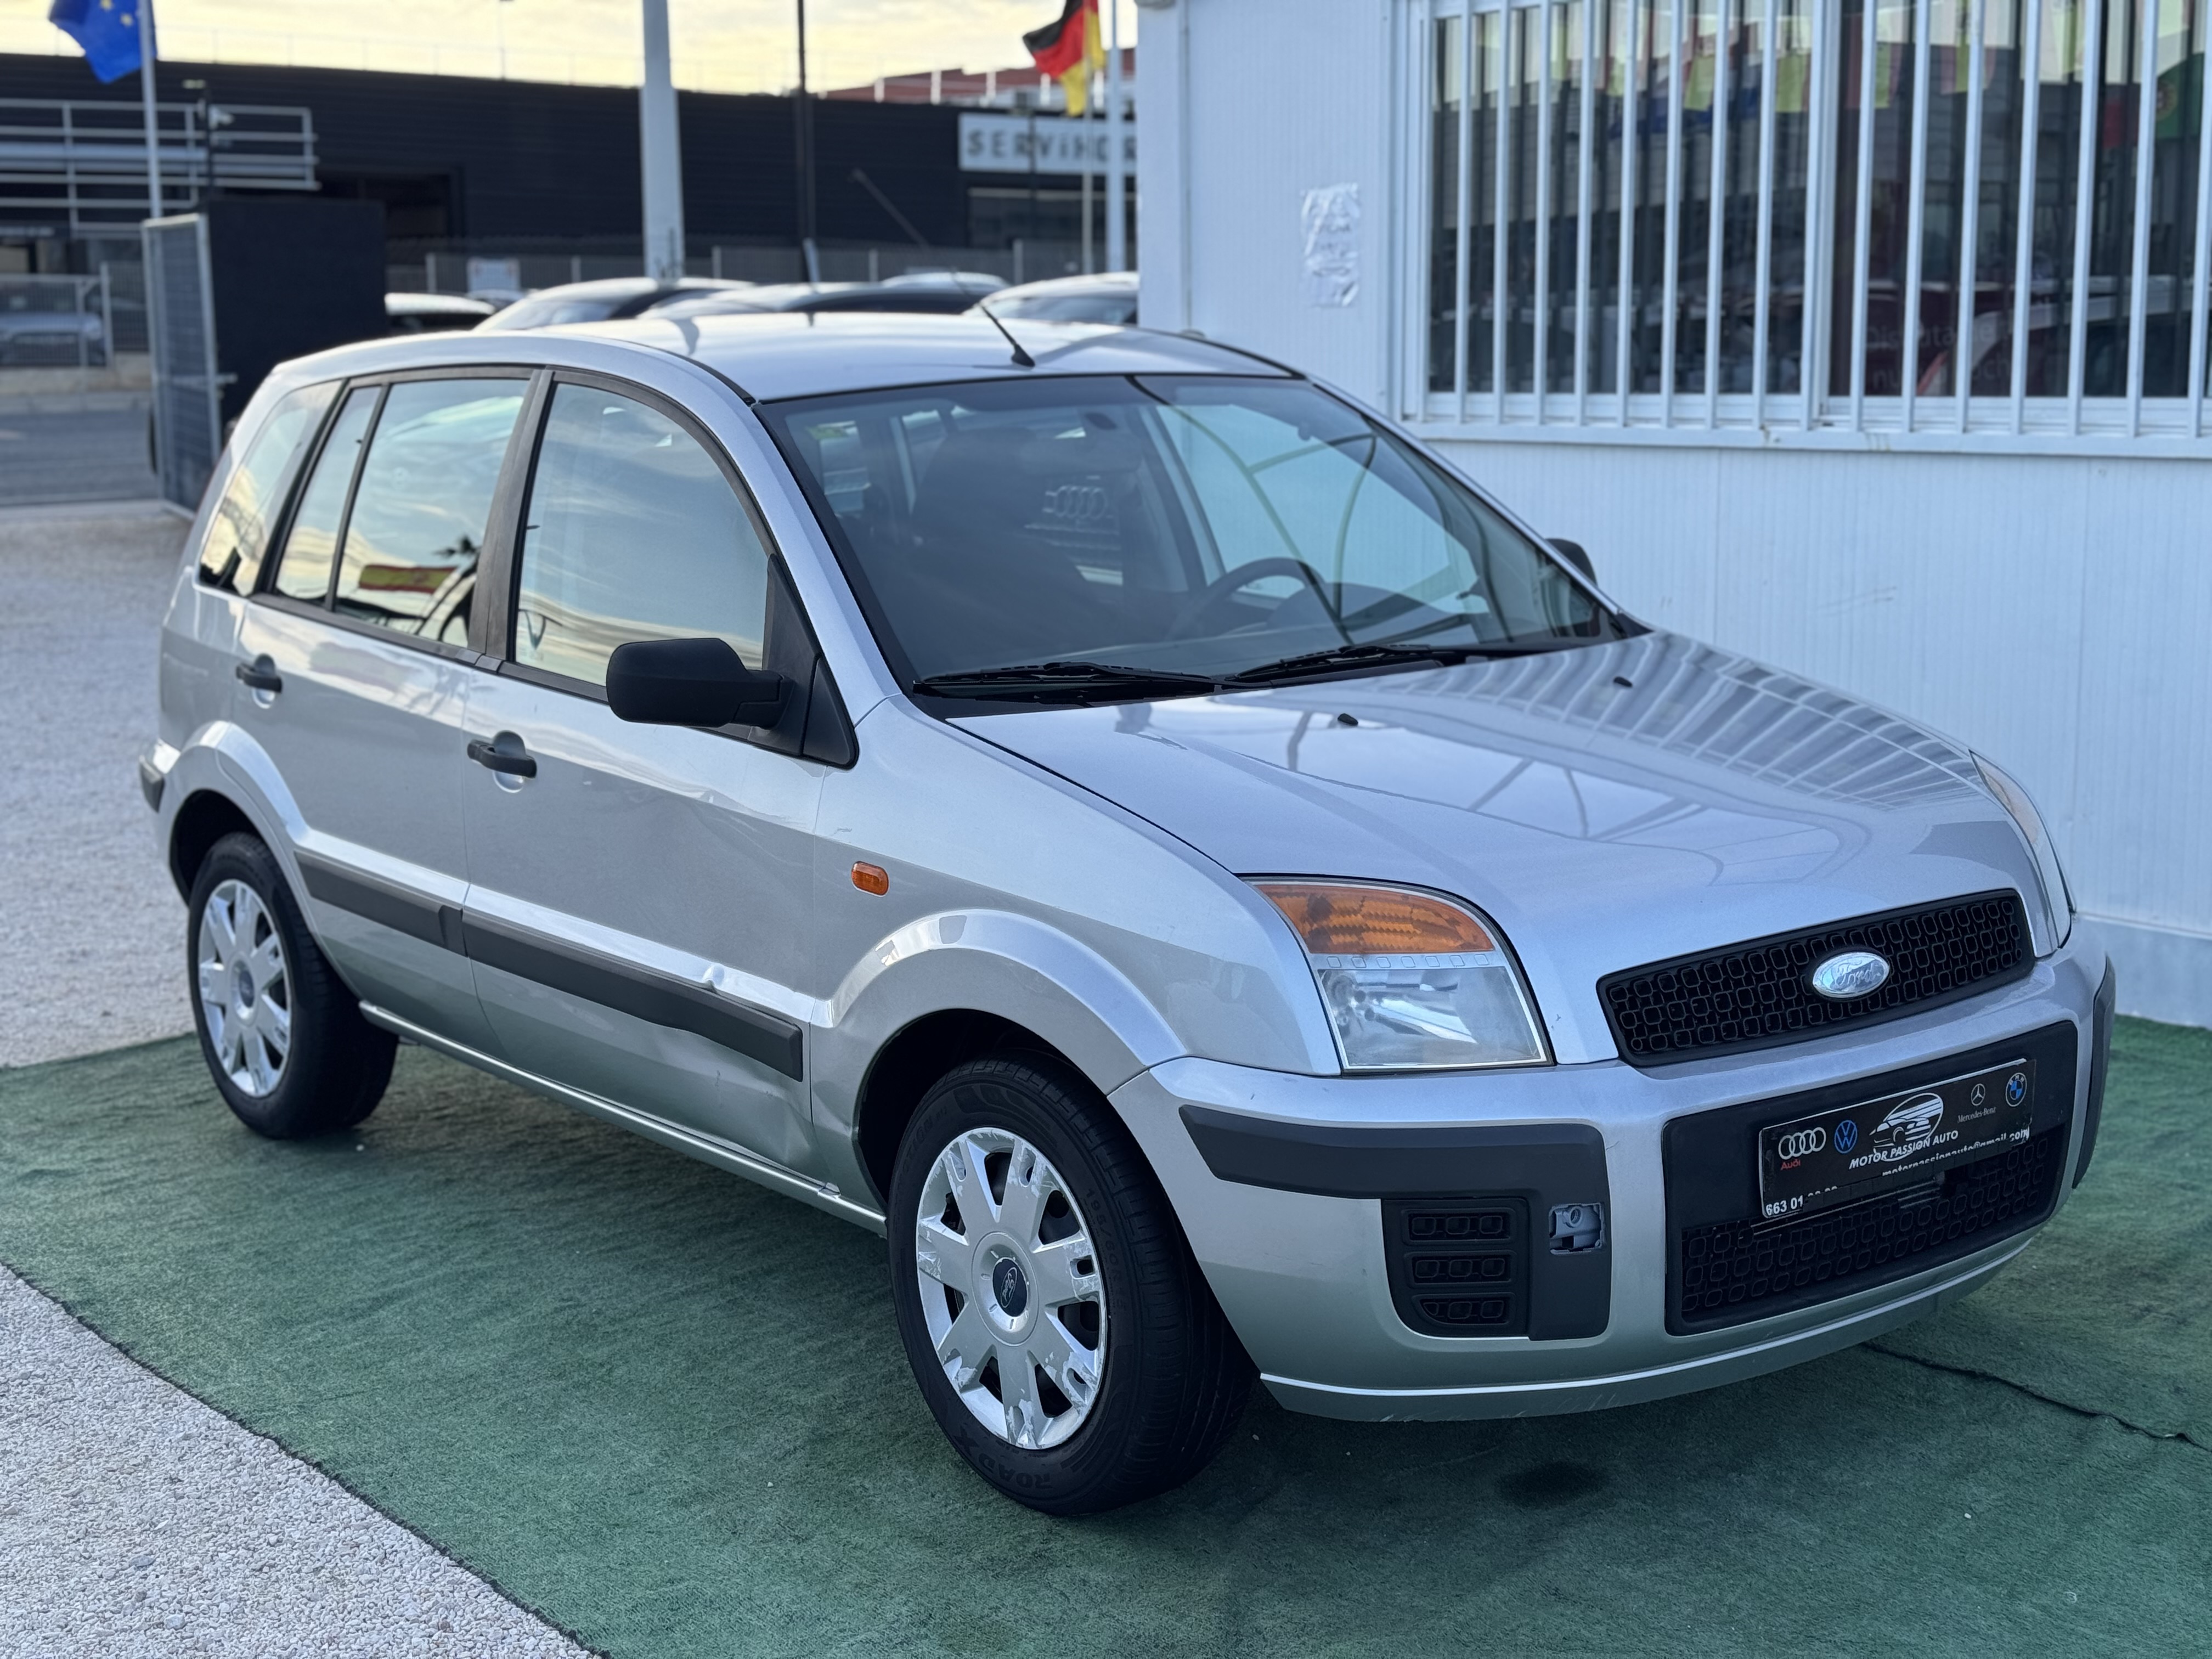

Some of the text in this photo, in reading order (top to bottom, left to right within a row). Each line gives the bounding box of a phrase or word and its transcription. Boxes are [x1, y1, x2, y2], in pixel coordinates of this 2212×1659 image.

[1832, 960, 1881, 987] Ford
[1957, 1107, 1996, 1124] Mercedes-Benz
[1848, 1130, 1959, 1170] MOTOR PASSION AUTO
[1780, 1159, 1801, 1171] Audi
[1765, 1194, 1803, 1216] 663 01
